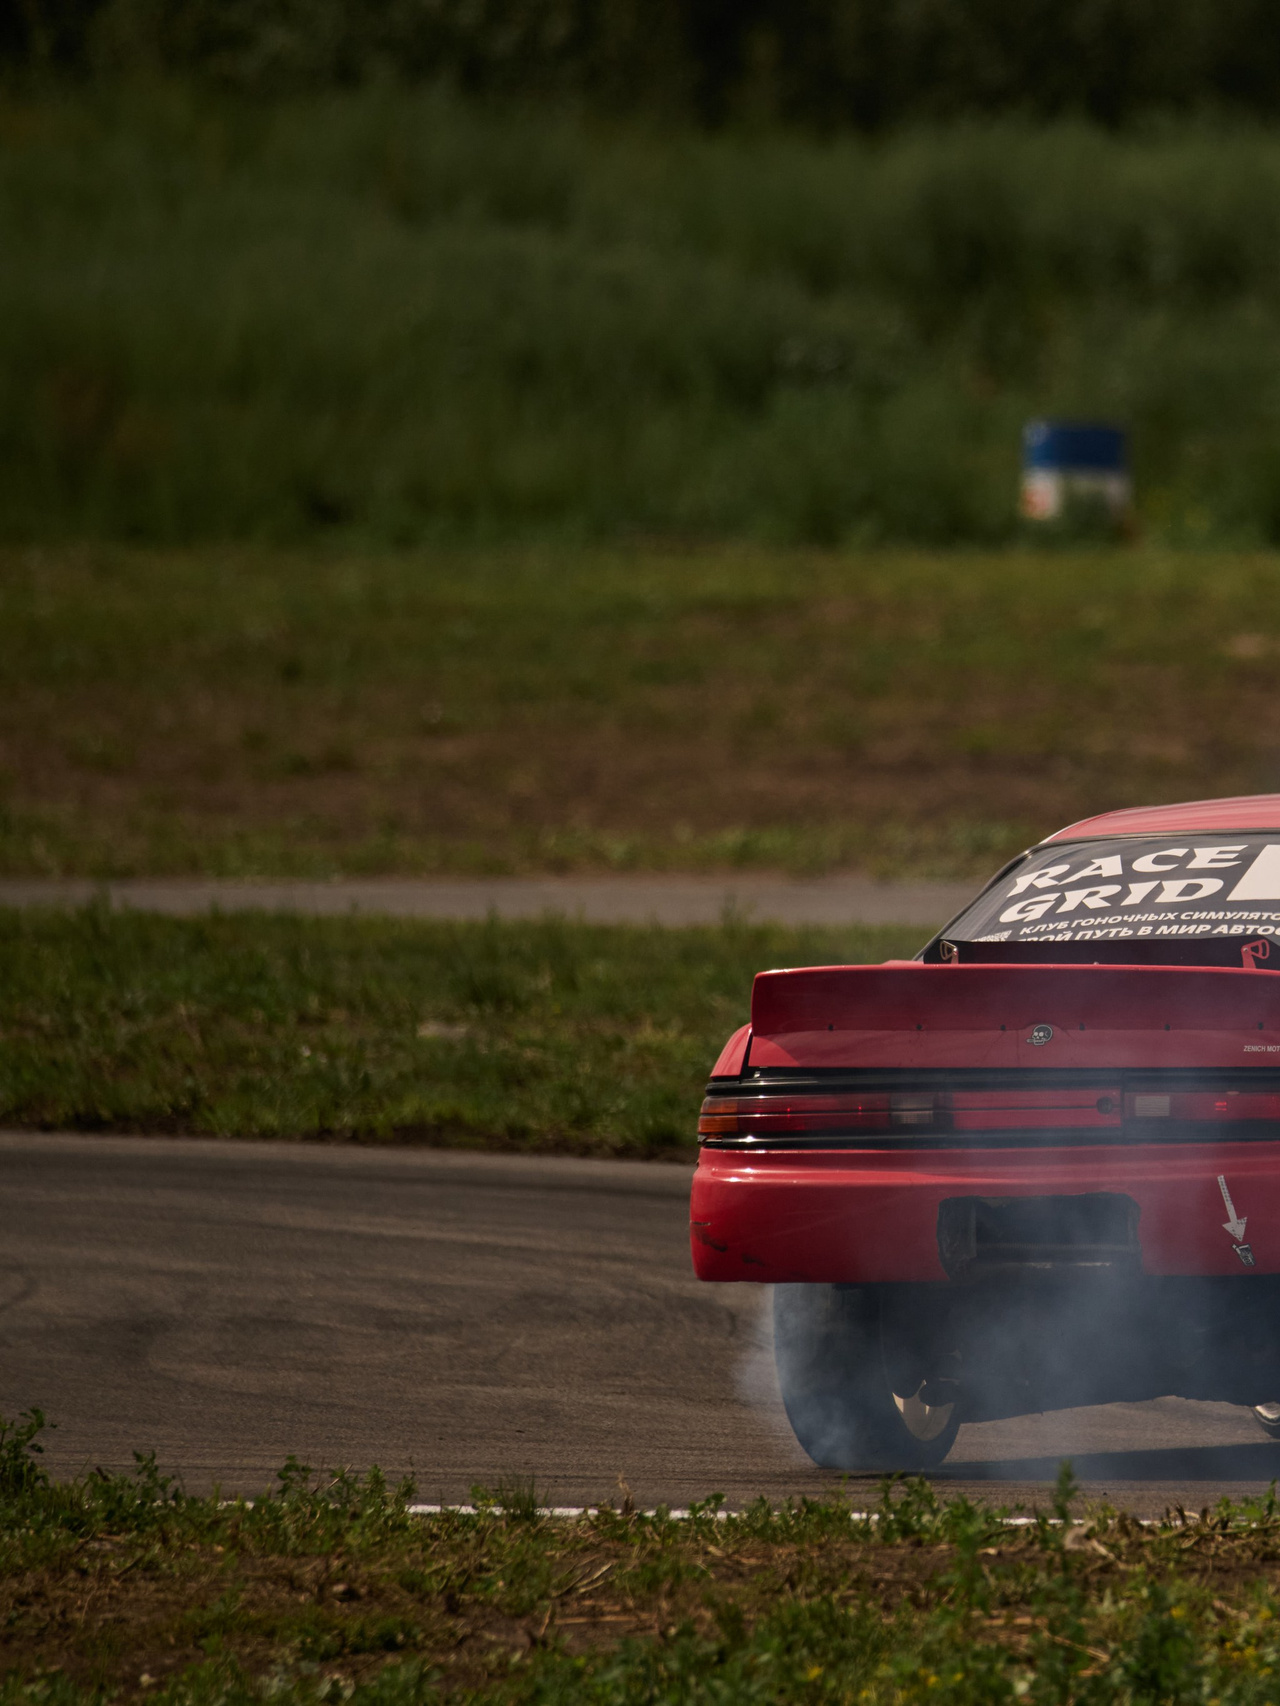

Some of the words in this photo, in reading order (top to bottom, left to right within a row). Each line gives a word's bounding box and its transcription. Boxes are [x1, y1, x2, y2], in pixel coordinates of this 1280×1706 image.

[1006, 845, 1248, 897] RACE
[999, 878, 1224, 922] GRID
[1020, 921, 1070, 935] КЛУБ
[1071, 911, 1178, 927] ГОНОЧНЫХ
[1073, 926, 1133, 941] ПУТЬ
[1136, 926, 1155, 936] В
[1154, 924, 1211, 935] МИР
